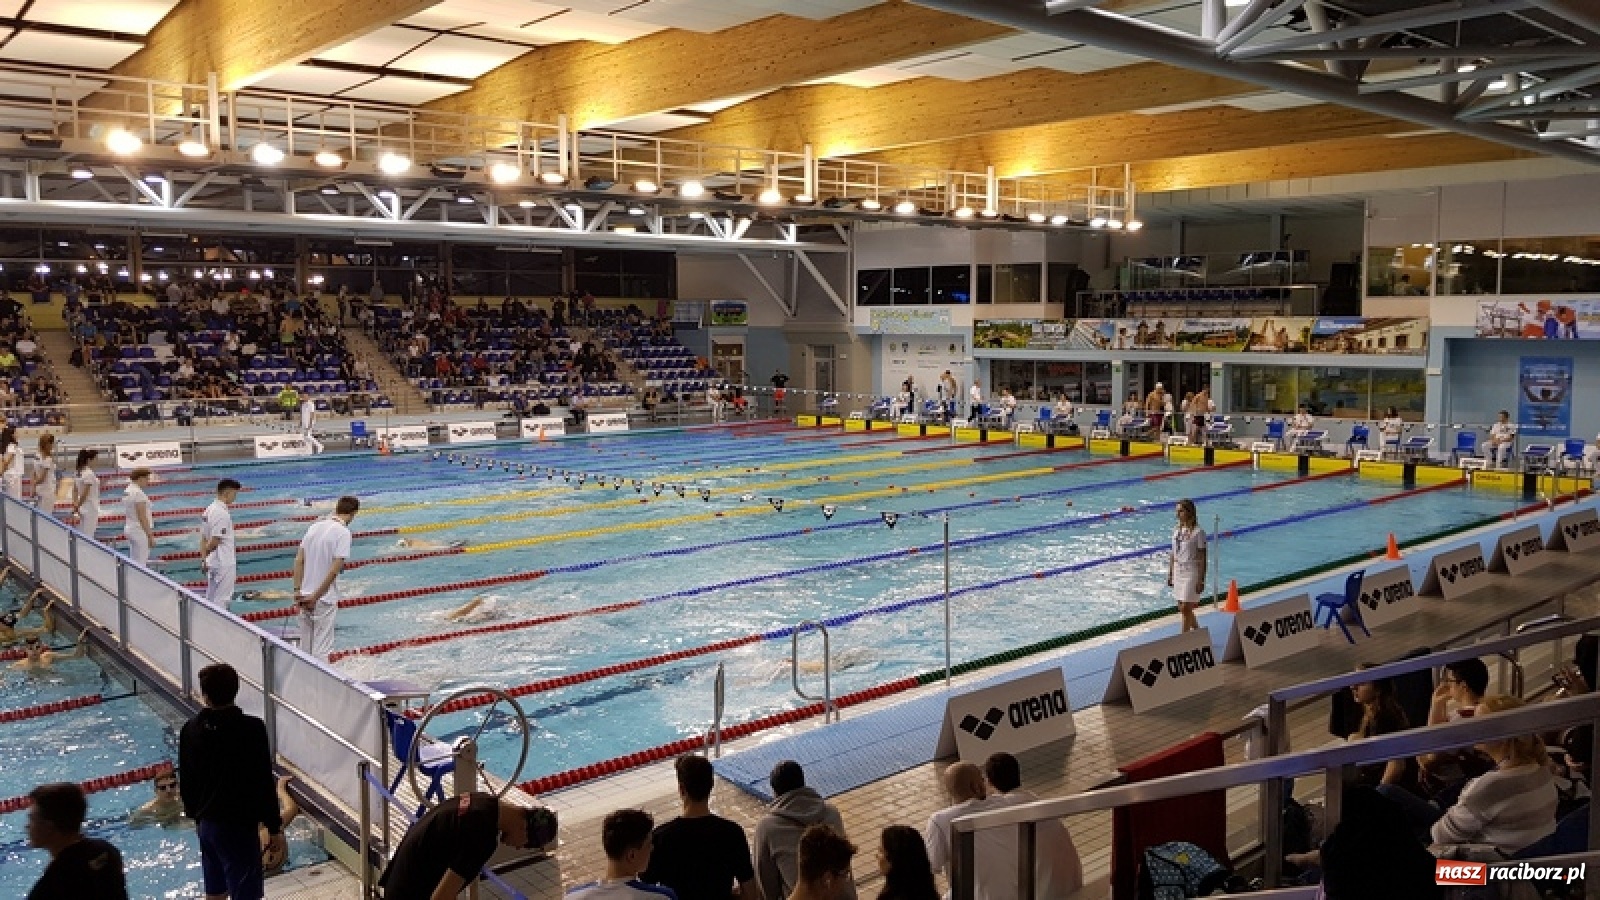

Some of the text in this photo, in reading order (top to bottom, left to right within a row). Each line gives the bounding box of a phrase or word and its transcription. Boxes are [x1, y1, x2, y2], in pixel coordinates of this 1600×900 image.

[145, 449, 179, 460] arena
[1522, 536, 1543, 556] arena
[1459, 556, 1485, 578] arena
[1383, 579, 1414, 604] arena
[1275, 609, 1314, 639] arena
[1166, 646, 1215, 678] arena
[1007, 688, 1067, 728] arena
